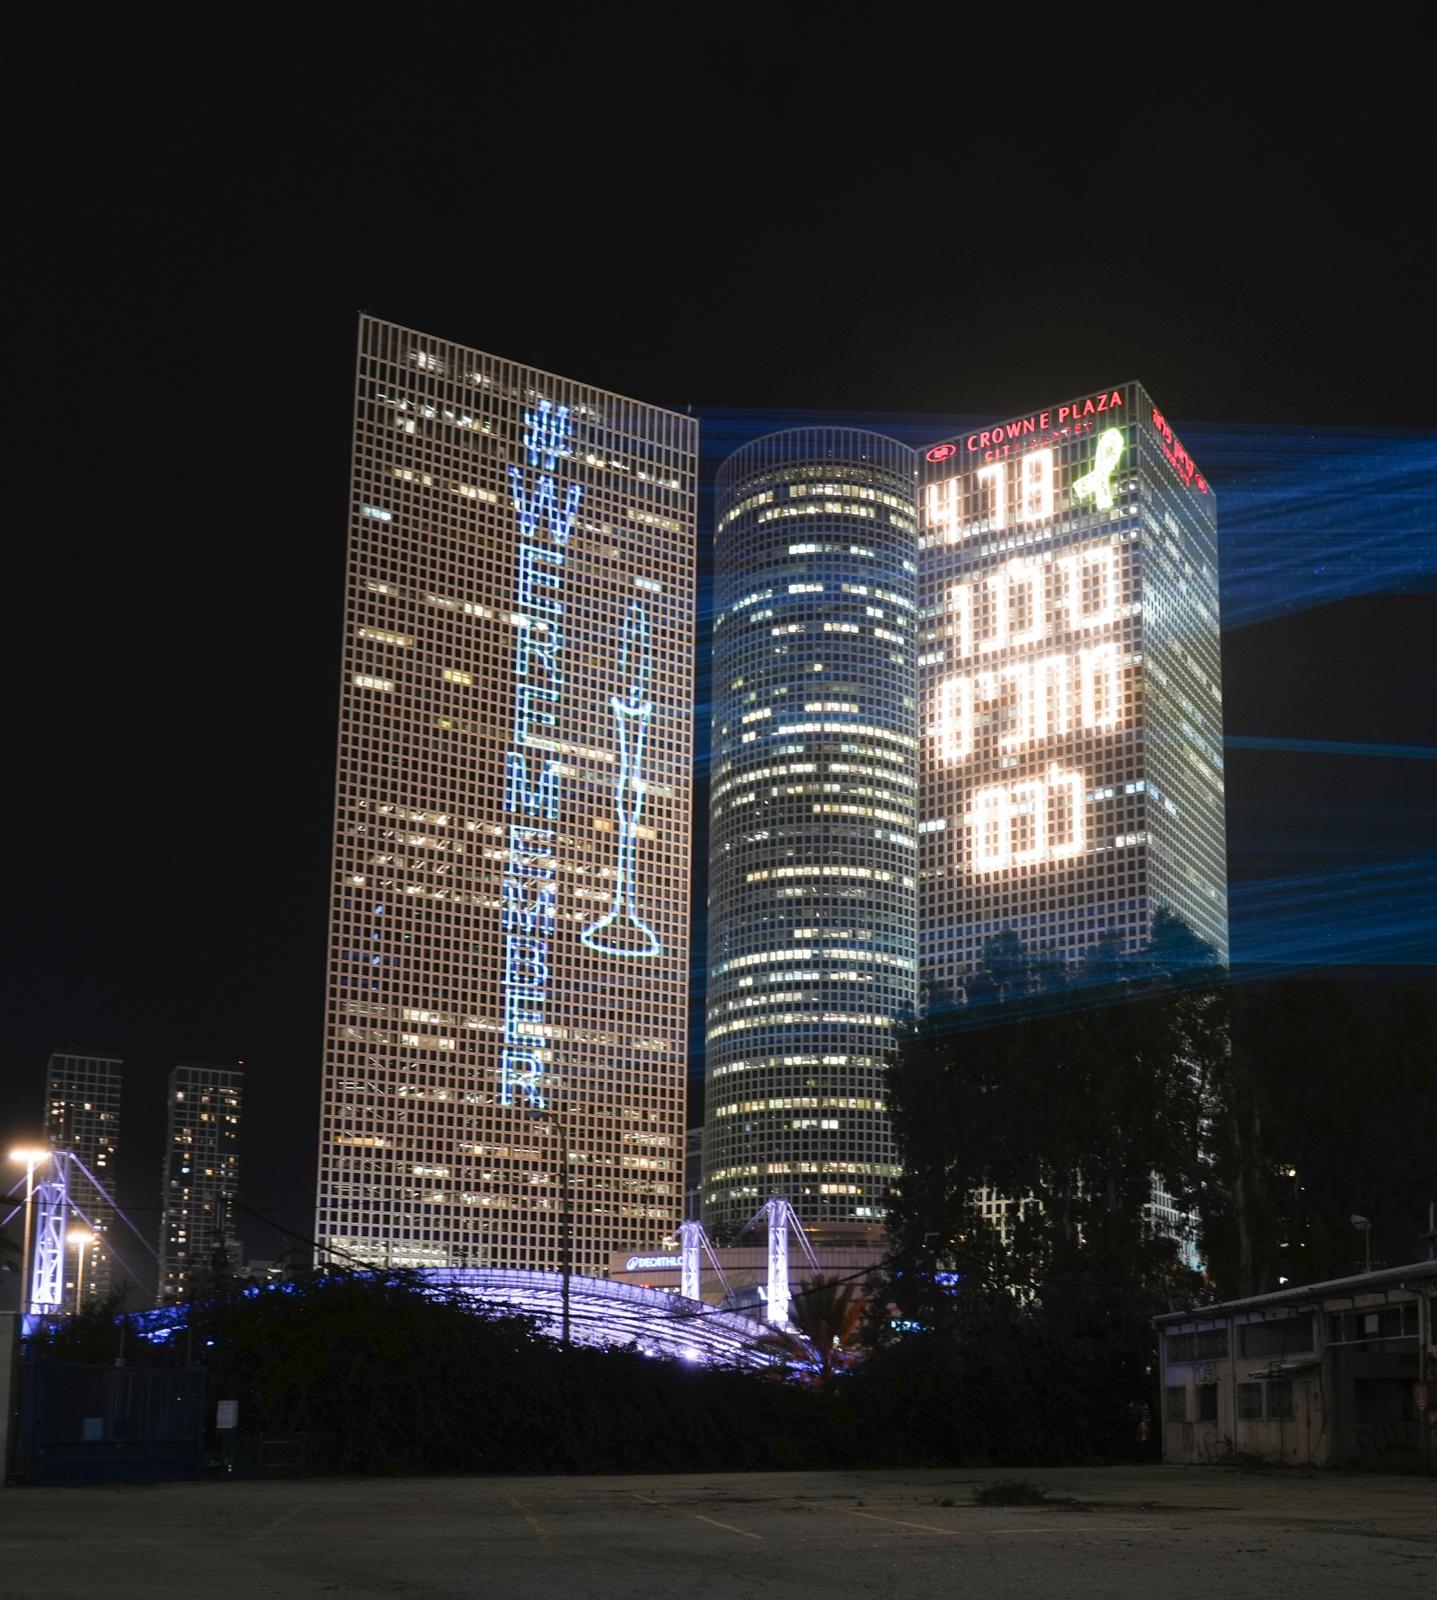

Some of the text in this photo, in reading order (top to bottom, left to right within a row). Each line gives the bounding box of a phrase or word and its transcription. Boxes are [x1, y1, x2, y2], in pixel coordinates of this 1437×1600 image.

[967, 391, 1123, 451] CROWNE PLAZA
[926, 449, 1053, 544] 478
[976, 763, 1084, 873] לכם
[638, 1255, 685, 1268] DECATHLO
